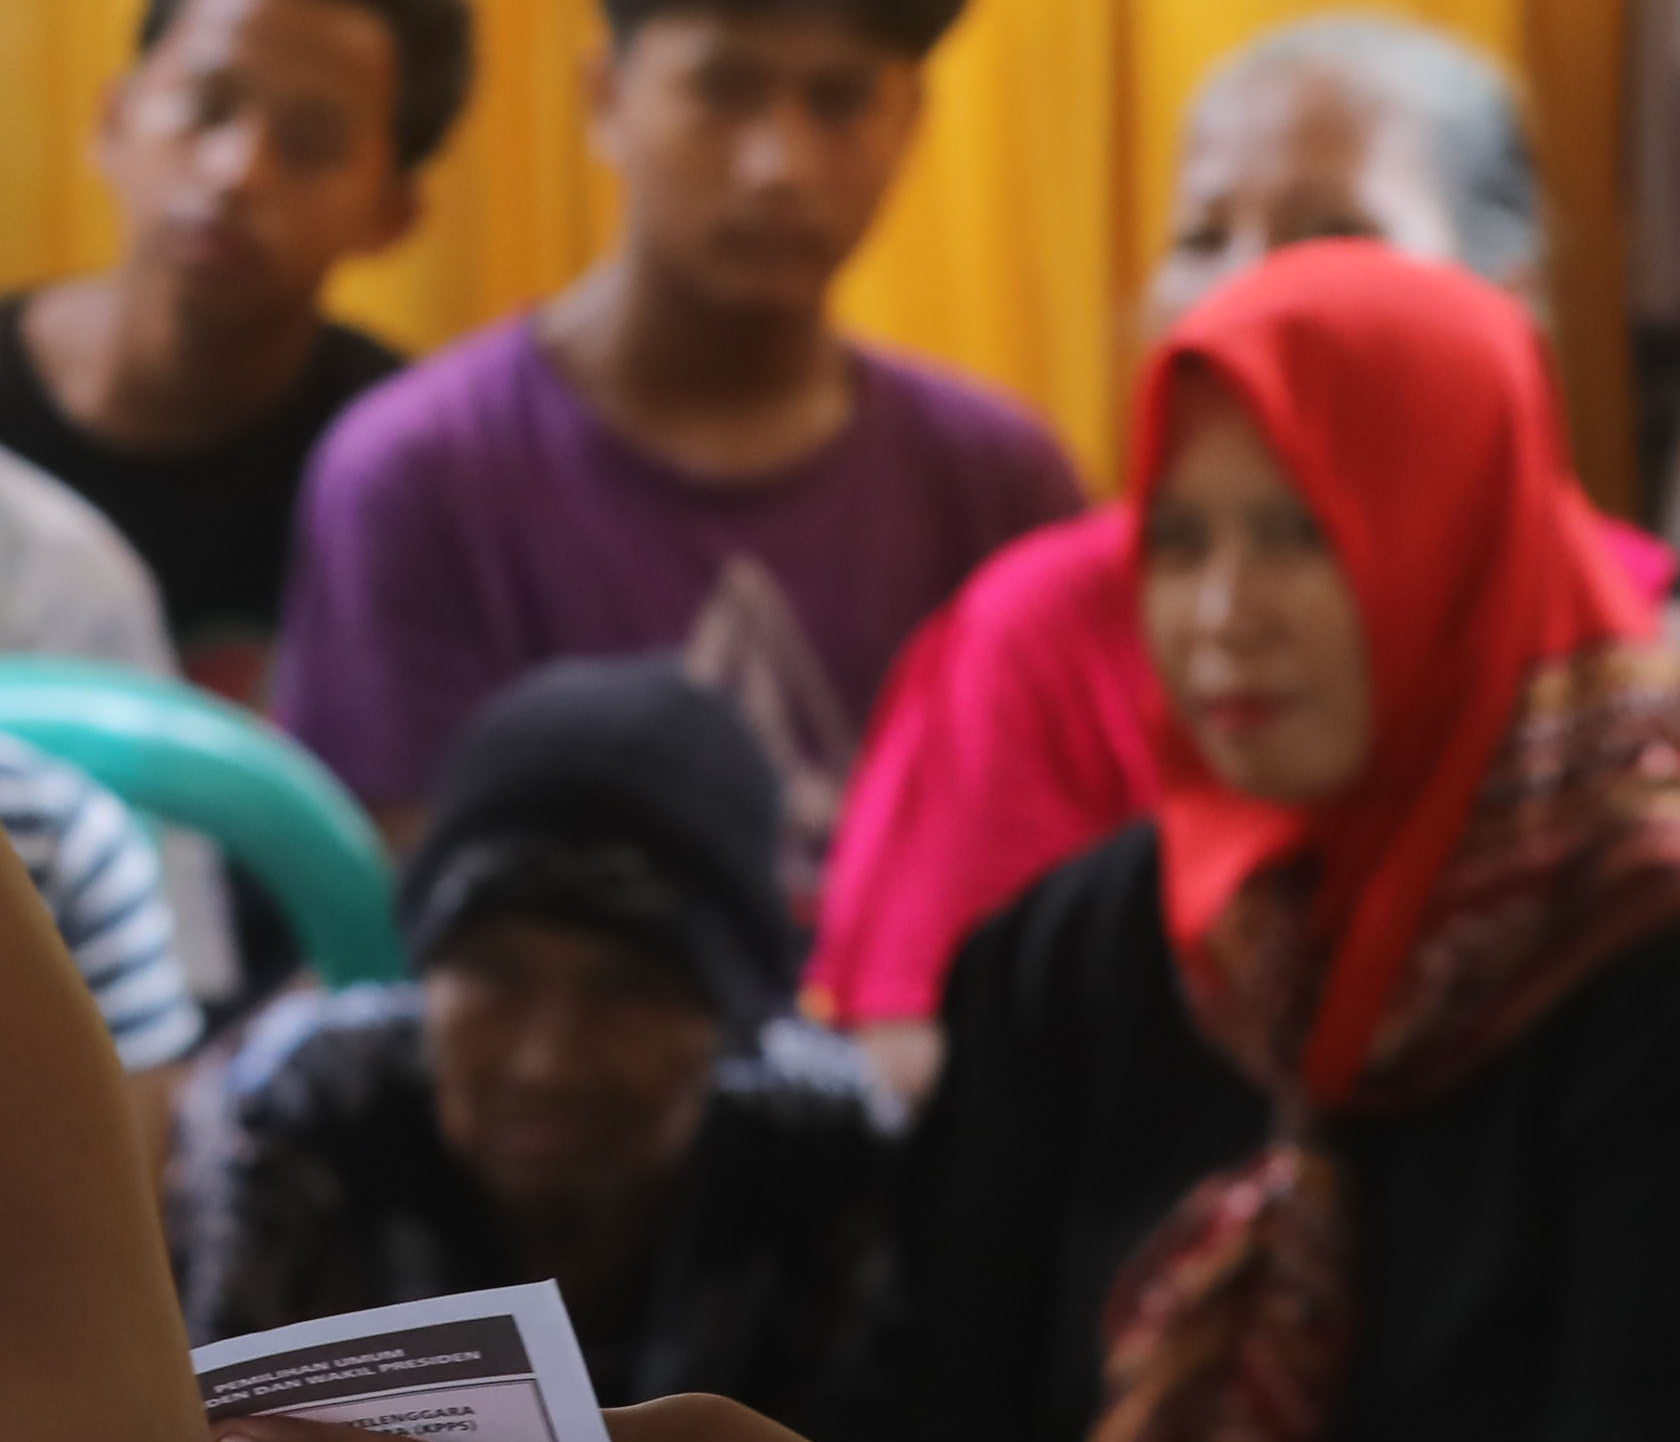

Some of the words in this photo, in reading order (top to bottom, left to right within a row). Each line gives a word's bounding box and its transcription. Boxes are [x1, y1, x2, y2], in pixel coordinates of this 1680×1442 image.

[205, 1390, 249, 1409] DEN
[253, 1378, 302, 1397] DAN
[307, 1366, 376, 1386] WAKIL
[380, 1350, 482, 1373] PRESIDEN
[214, 1360, 330, 1395] PEMILIHAN
[335, 1348, 406, 1368] UMUM
